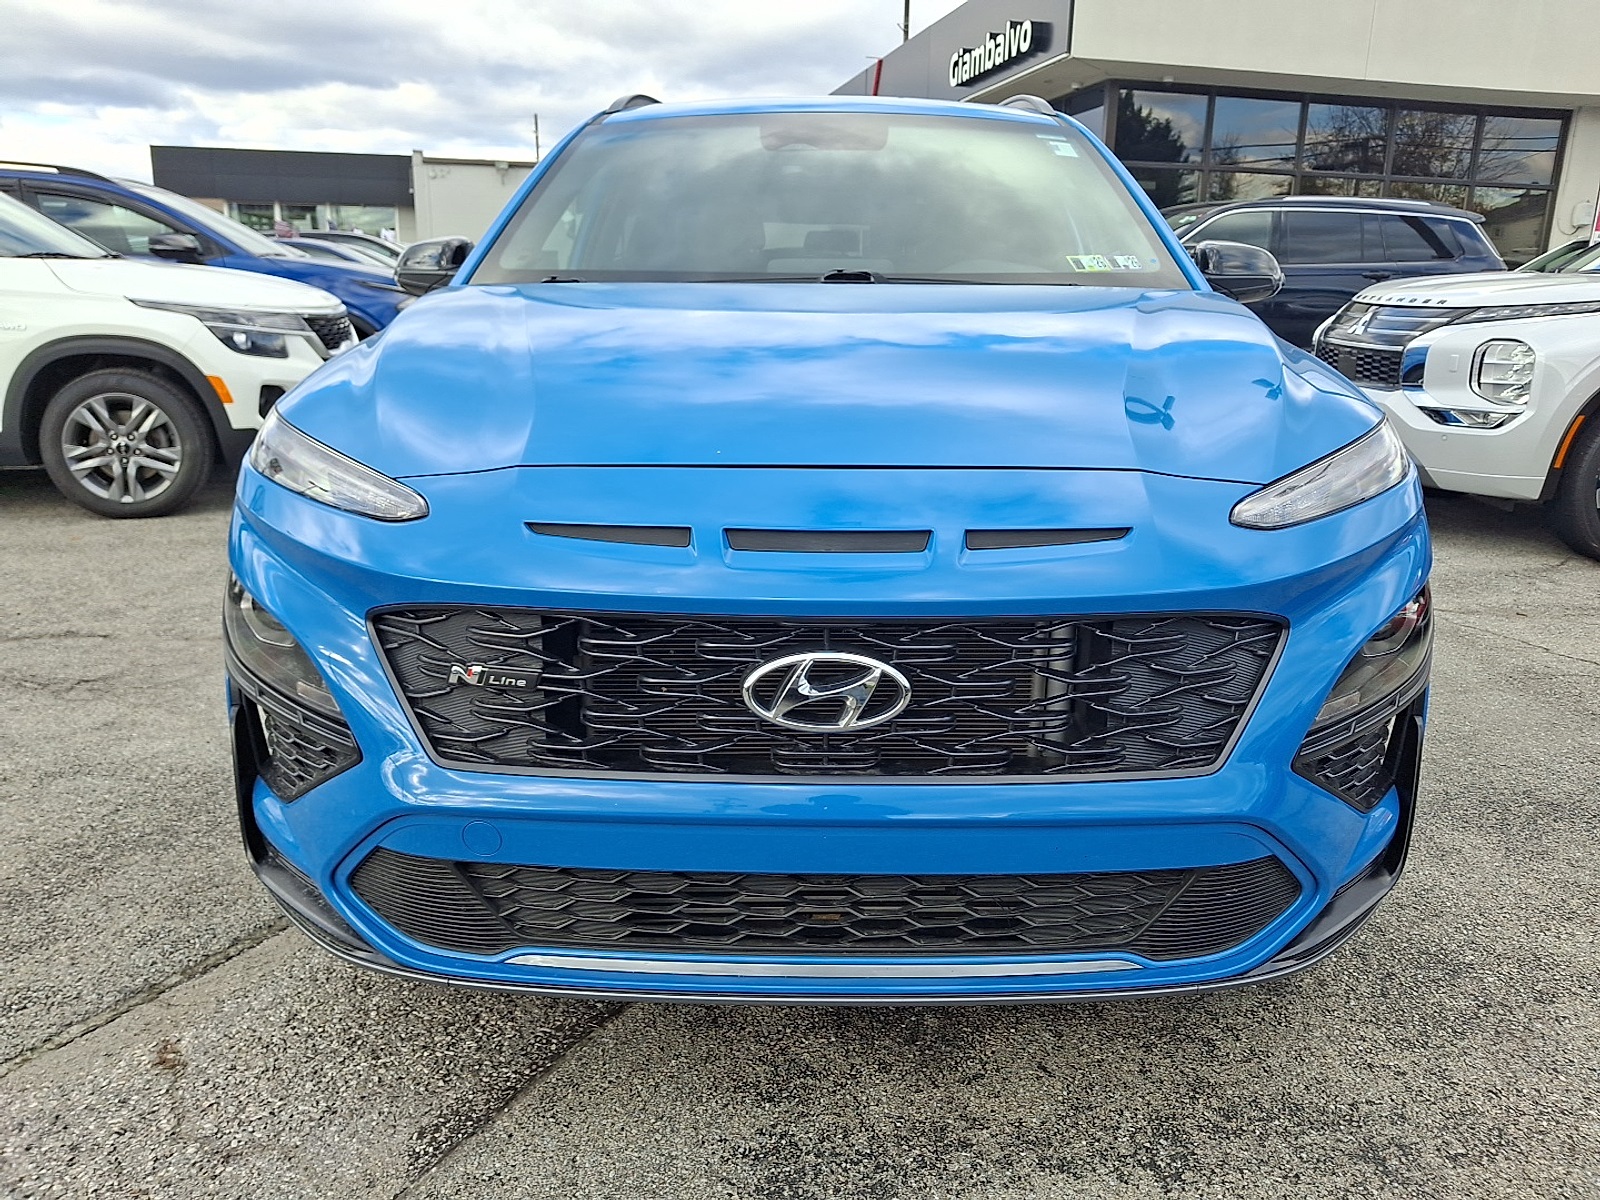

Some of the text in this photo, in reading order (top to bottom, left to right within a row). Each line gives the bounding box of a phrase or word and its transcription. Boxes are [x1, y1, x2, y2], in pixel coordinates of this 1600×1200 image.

[949, 19, 1032, 87] Giambalvo
[448, 665, 527, 687] N Line
